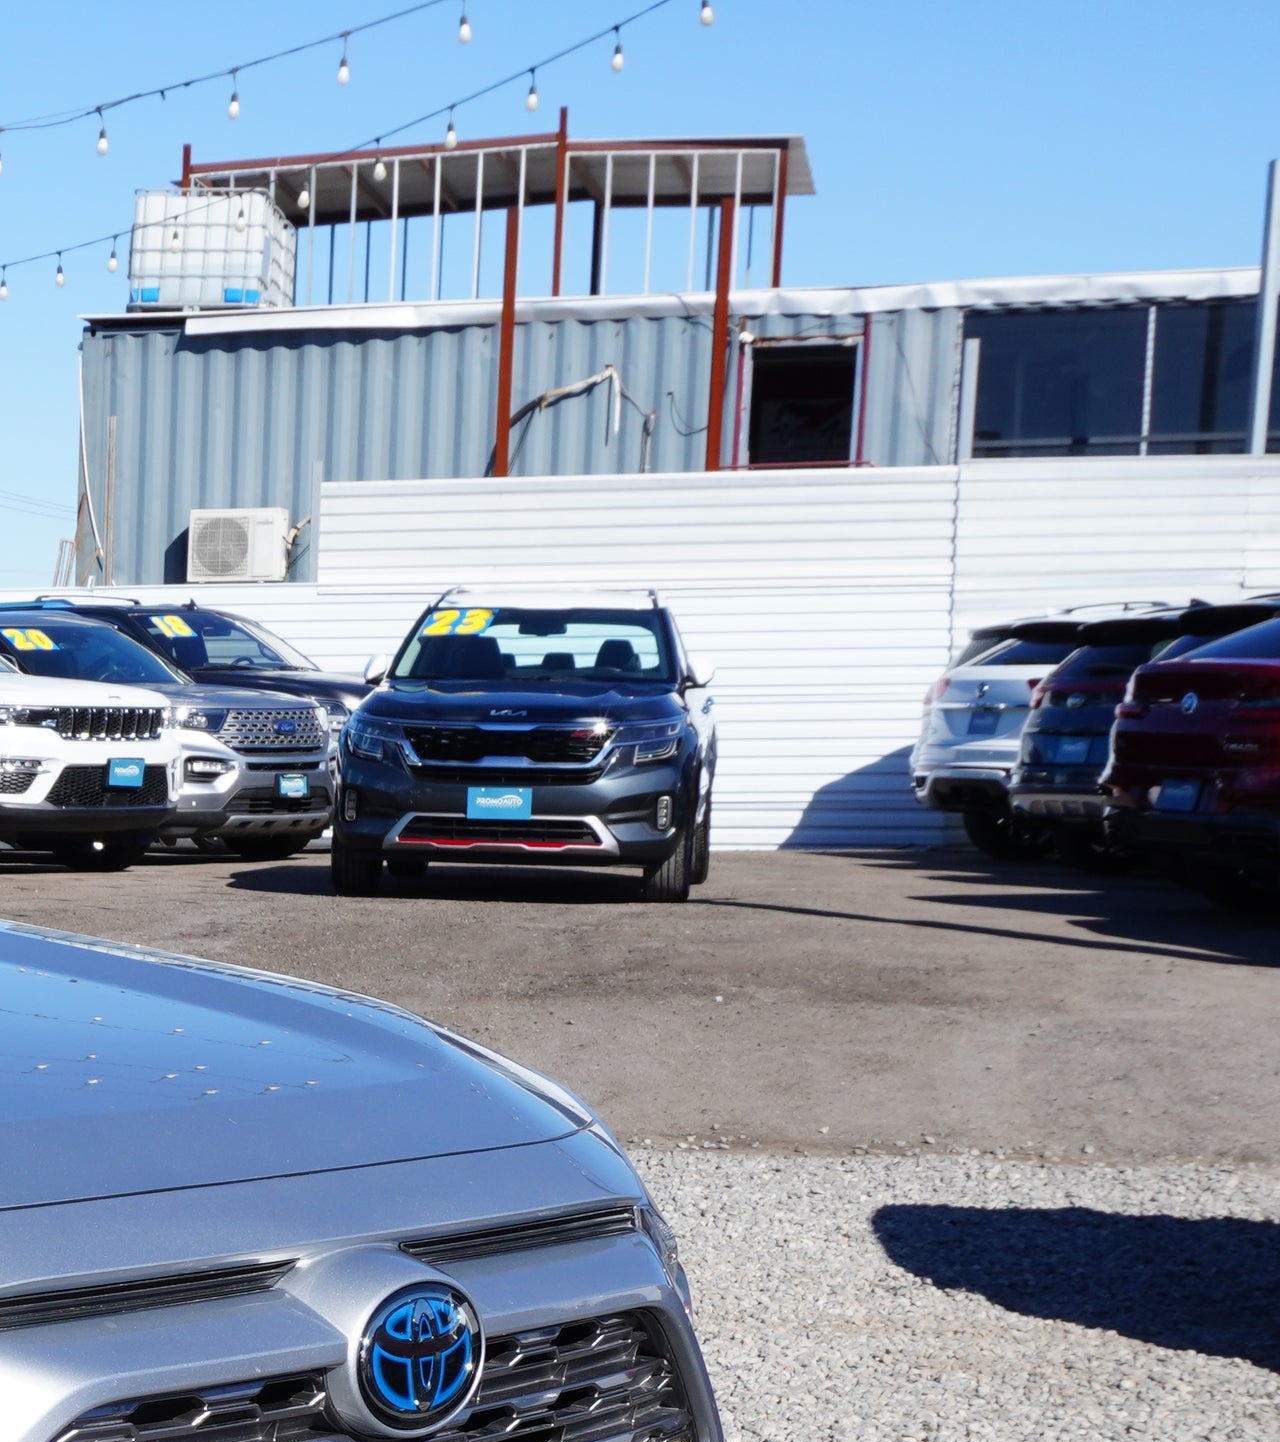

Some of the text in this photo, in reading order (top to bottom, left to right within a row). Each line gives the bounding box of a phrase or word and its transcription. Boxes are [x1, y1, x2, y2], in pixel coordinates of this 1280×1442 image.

[153, 615, 193, 637] 18
[422, 609, 494, 636] 23
[4, 628, 54, 651] 20
[476, 797, 523, 805] PROMOAUTO
